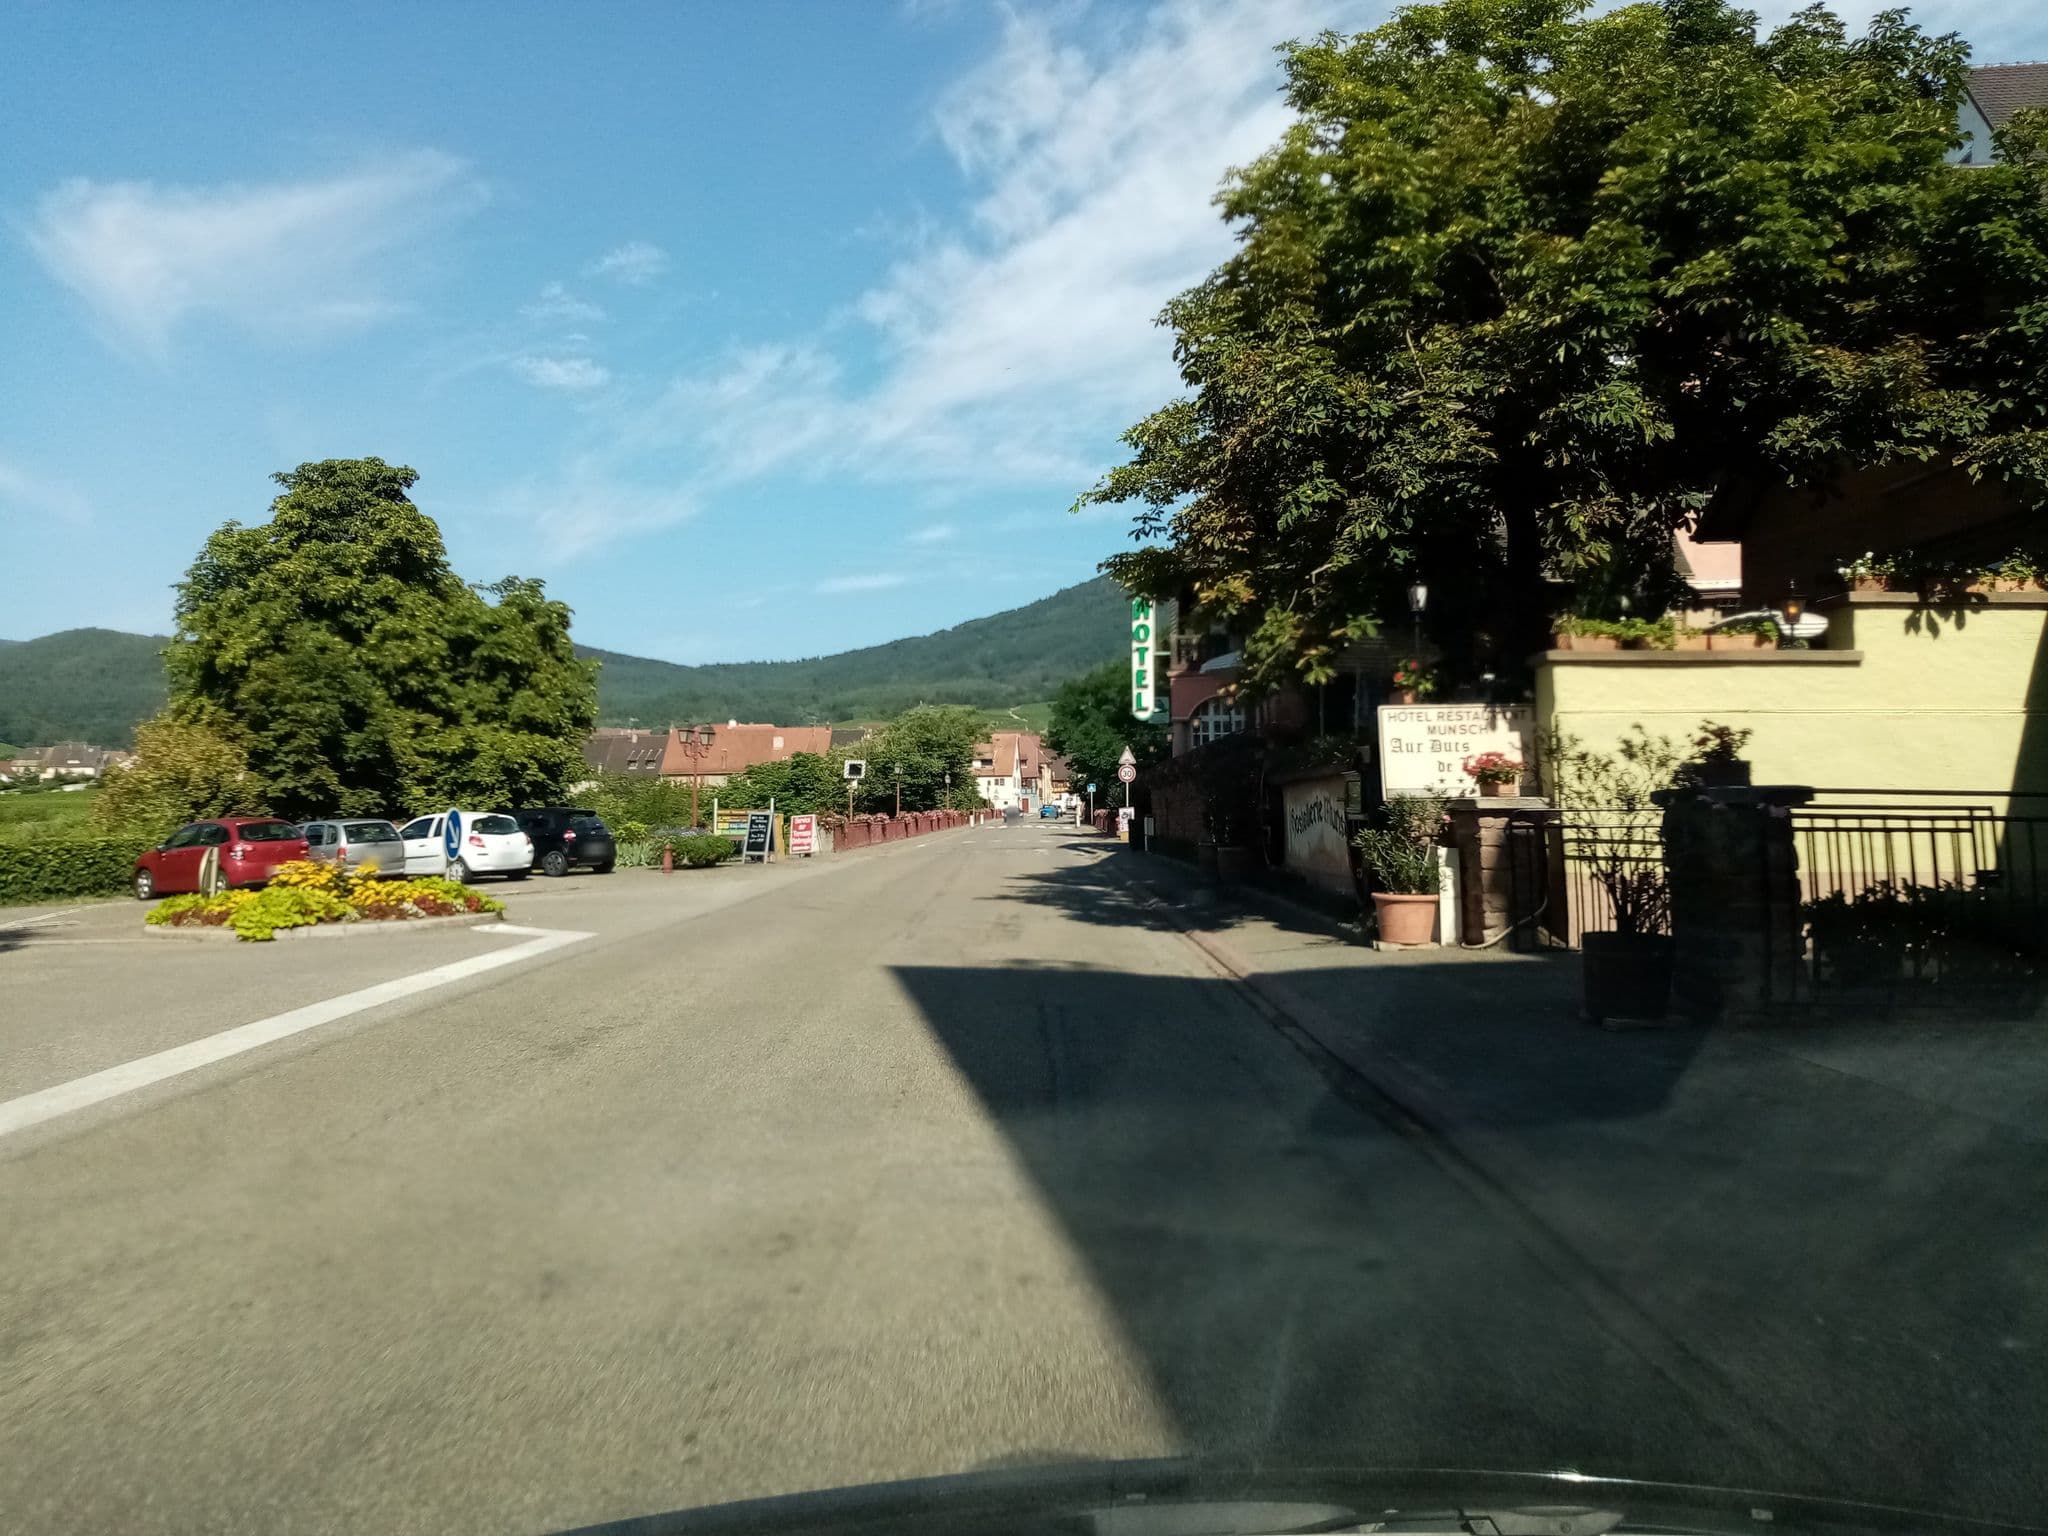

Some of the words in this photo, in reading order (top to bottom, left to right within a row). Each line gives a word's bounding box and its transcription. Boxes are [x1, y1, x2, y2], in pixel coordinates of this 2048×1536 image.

[1132, 598, 1151, 712] HOTEL
[1388, 711, 1432, 722] HOTEL
[1436, 710, 1527, 722] RESTAUNT
[1427, 724, 1489, 736] MUNSCH
